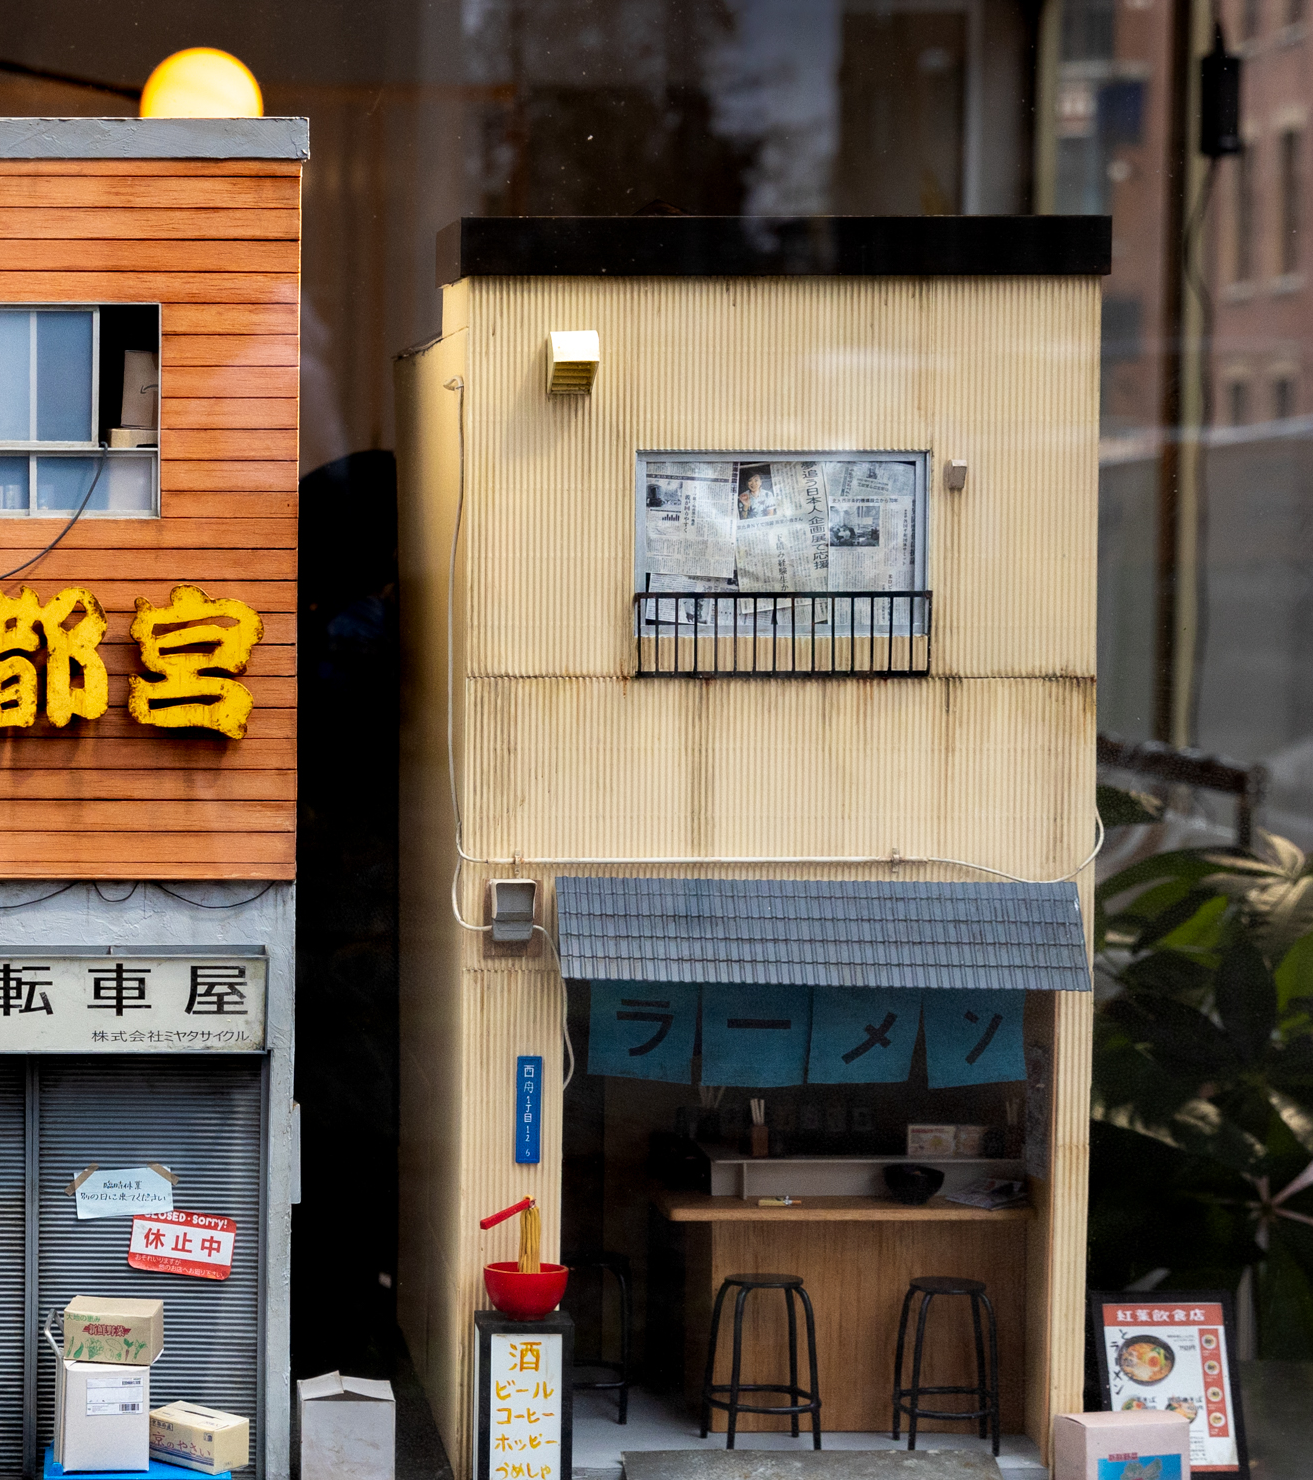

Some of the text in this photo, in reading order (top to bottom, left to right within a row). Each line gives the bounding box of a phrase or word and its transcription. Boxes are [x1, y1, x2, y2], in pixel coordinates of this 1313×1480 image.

[91, 1030, 250, 1044] 株式会社ミヤタサイクル
[616, 998, 1004, 1066] ラーメン
[144, 1227, 222, 1257] 休止中
[1116, 1309, 1206, 1322] 紅葉飲食店
[88, 1323, 126, 1337] 新鮮野菜
[508, 1341, 542, 1372] 酒
[495, 1379, 555, 1401] ビール
[496, 1407, 555, 1425] コーヒー
[152, 1431, 212, 1457] 京のやさい
[494, 1433, 558, 1452] ホッピー
